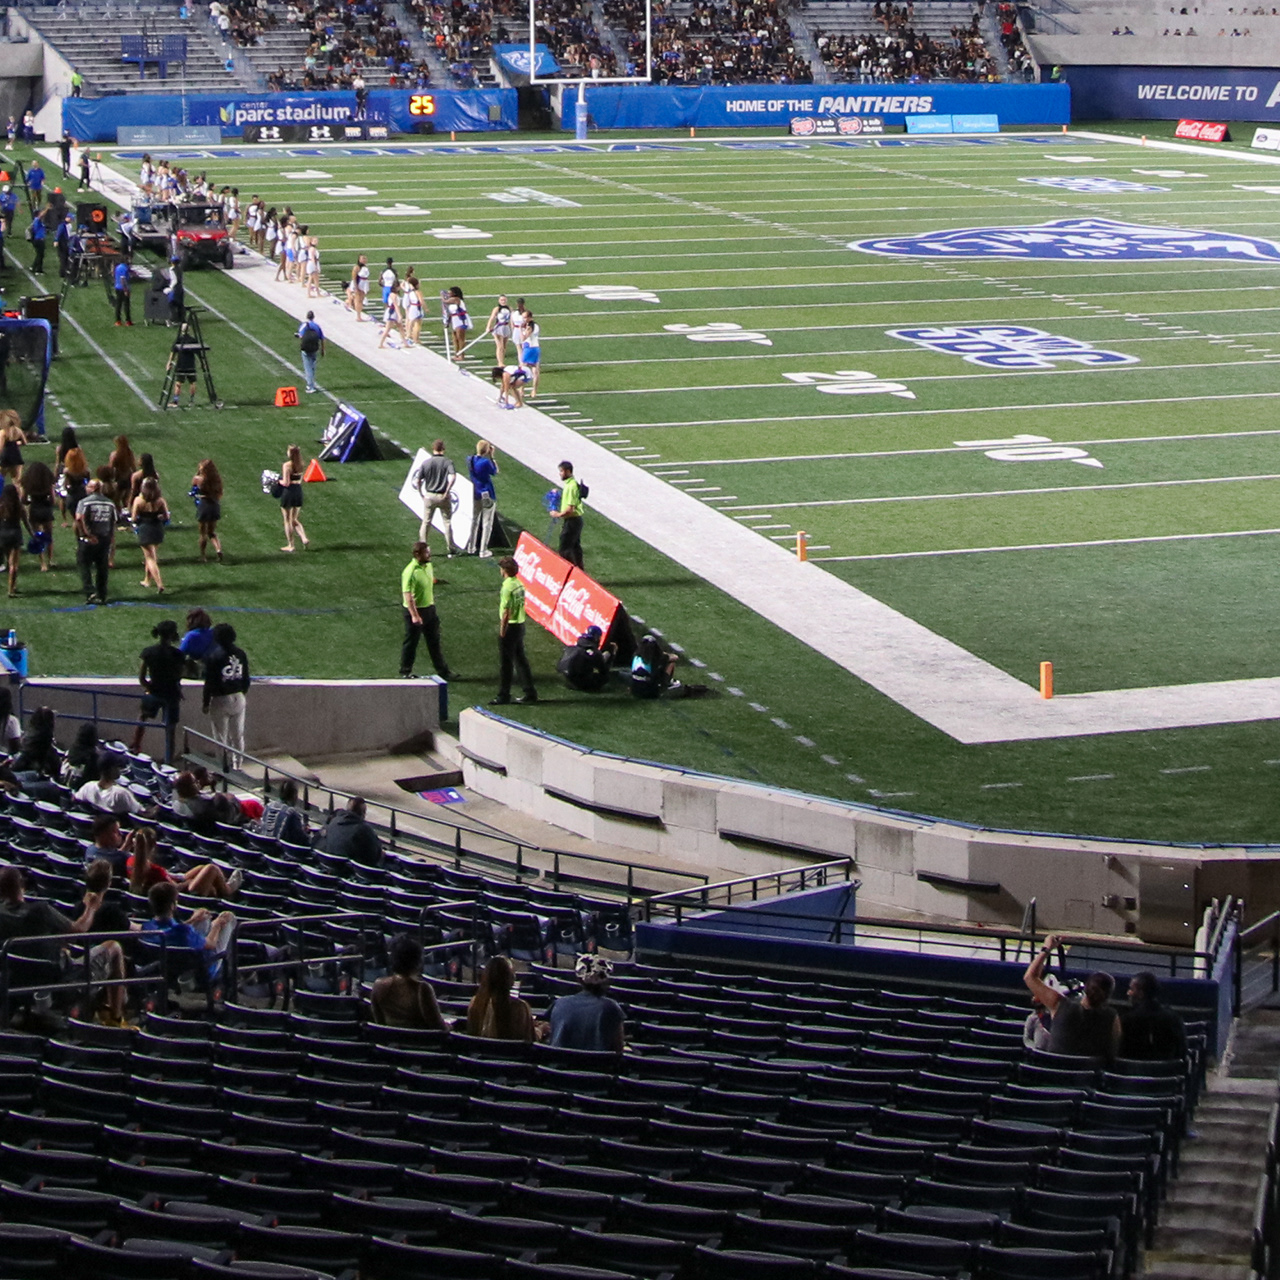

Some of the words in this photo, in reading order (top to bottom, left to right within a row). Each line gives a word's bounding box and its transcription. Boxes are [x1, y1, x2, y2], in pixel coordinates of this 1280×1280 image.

[1137, 84, 1232, 101] WELCOME
[1235, 86, 1259, 101] TO
[410, 95, 435, 115] 25
[726, 100, 766, 112] HOME
[767, 100, 786, 112] OF
[787, 100, 813, 111] THE
[817, 96, 932, 113] PANTHERS
[235, 107, 275, 125] parc
[276, 105, 351, 121] stadium
[663, 323, 767, 342] 30
[781, 370, 909, 394] 20
[282, 389, 297, 406] 20
[953, 434, 1089, 463] 10
